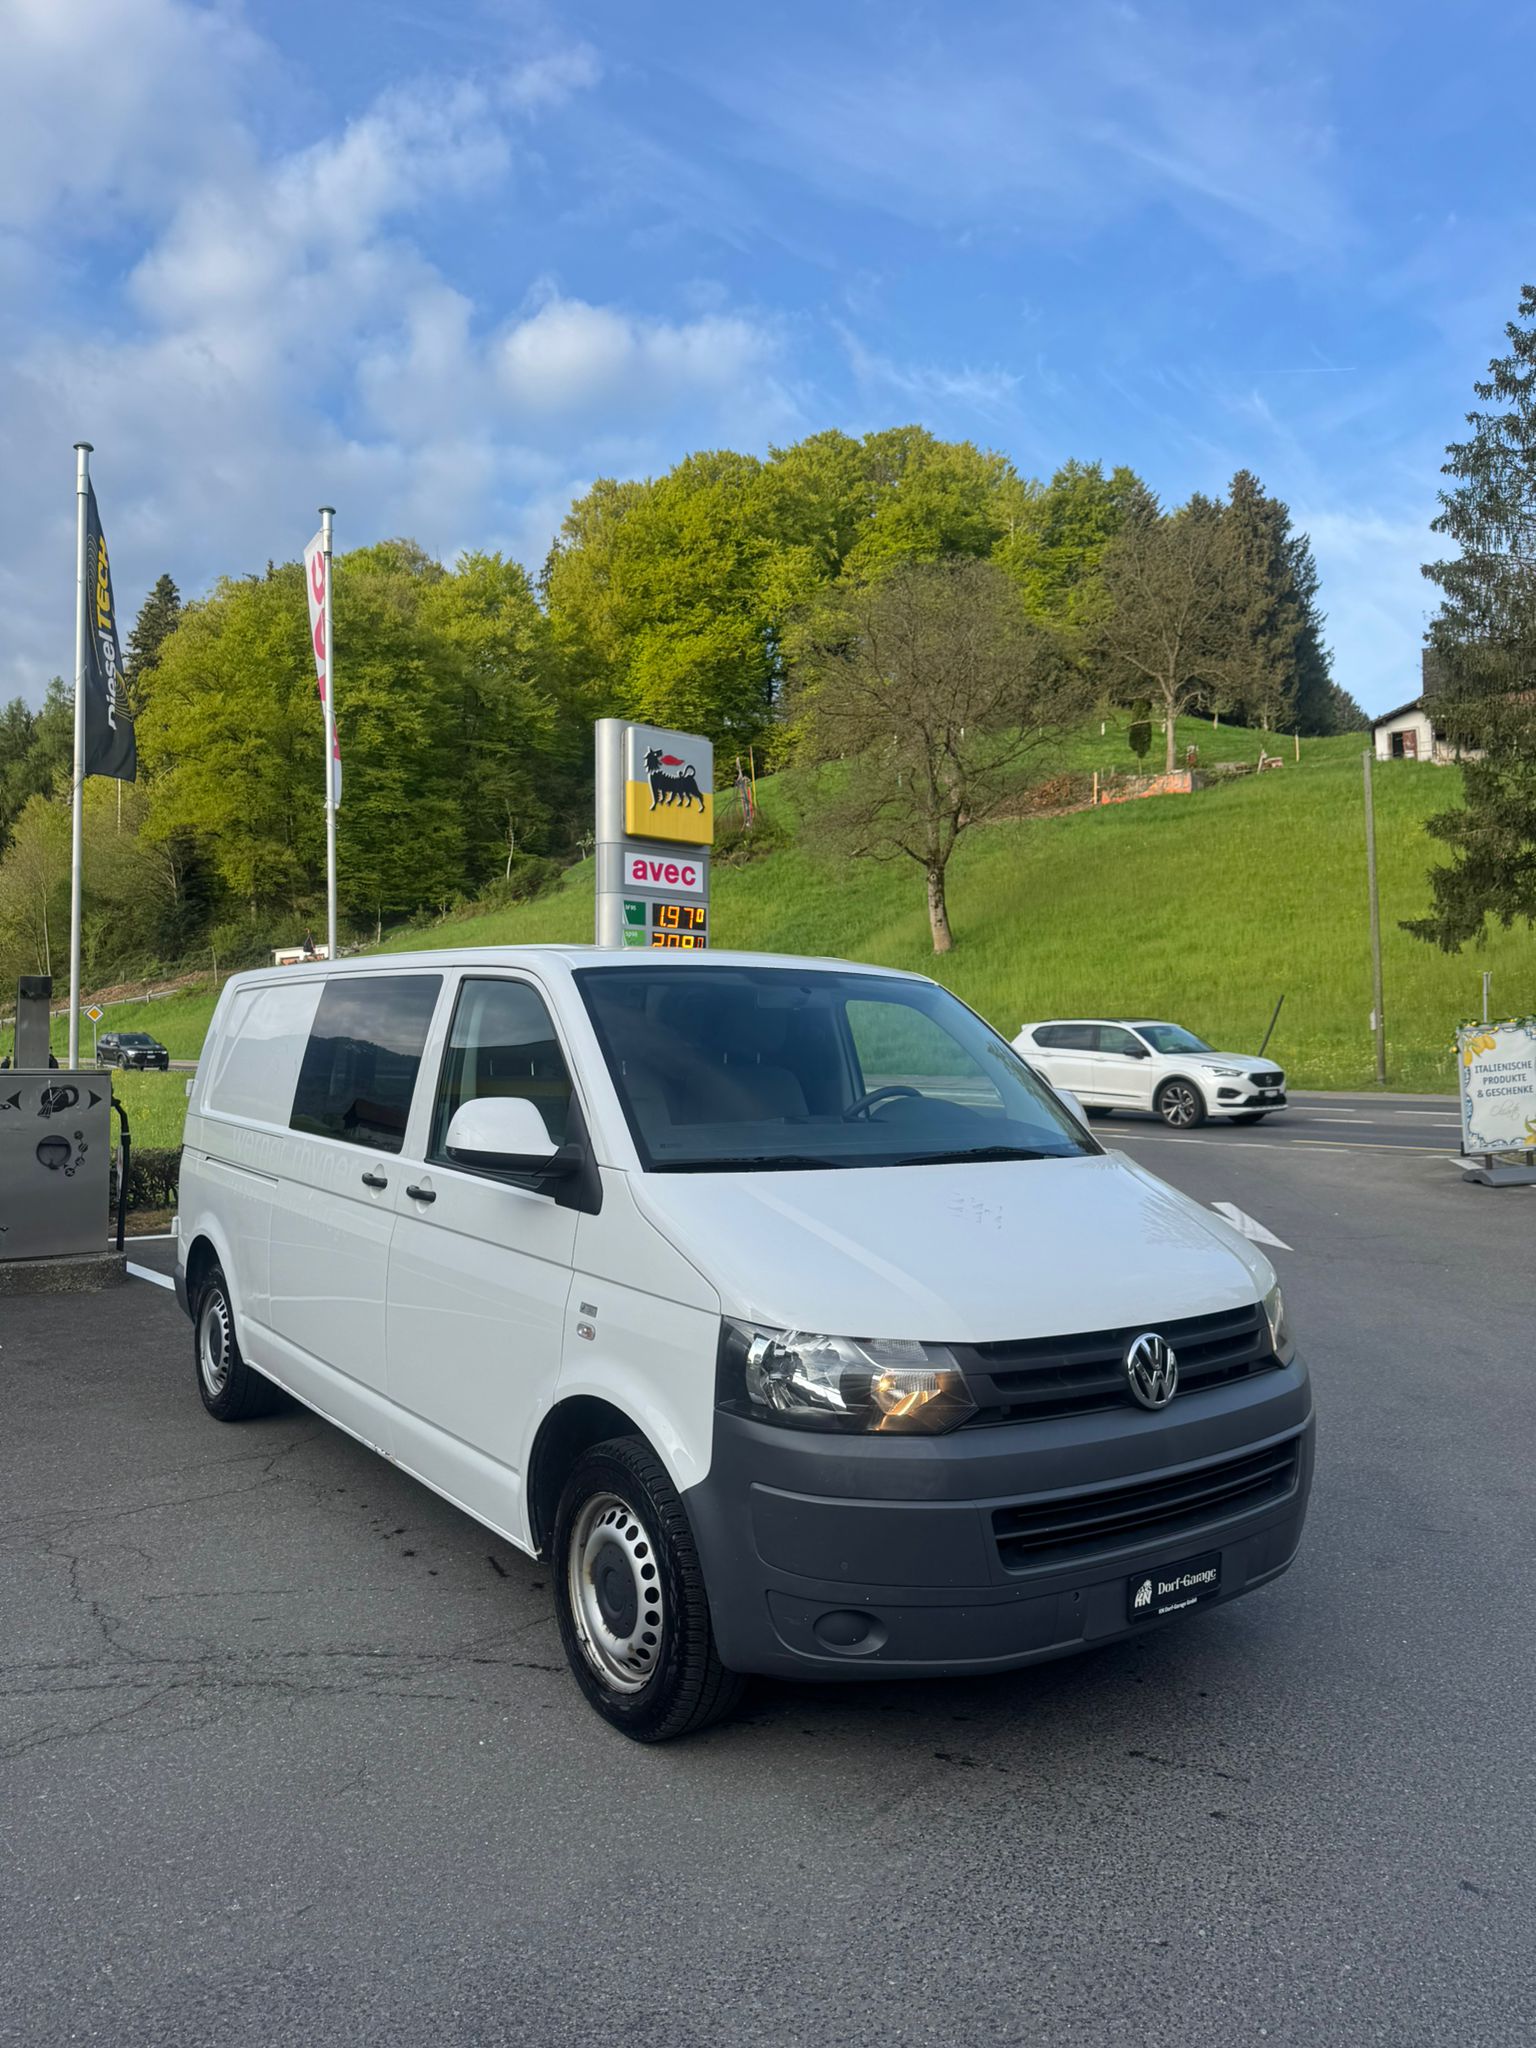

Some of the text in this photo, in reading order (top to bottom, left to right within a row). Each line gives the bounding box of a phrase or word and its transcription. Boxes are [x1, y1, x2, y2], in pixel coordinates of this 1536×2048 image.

[632, 859, 696, 886] avec
[1475, 1060, 1532, 1074] ITALIENISCHE
[1483, 1073, 1527, 1085] PRODUKTE
[1477, 1085, 1534, 1098] & GESCHENKE
[1158, 1569, 1216, 1595] Dorf-Garage
